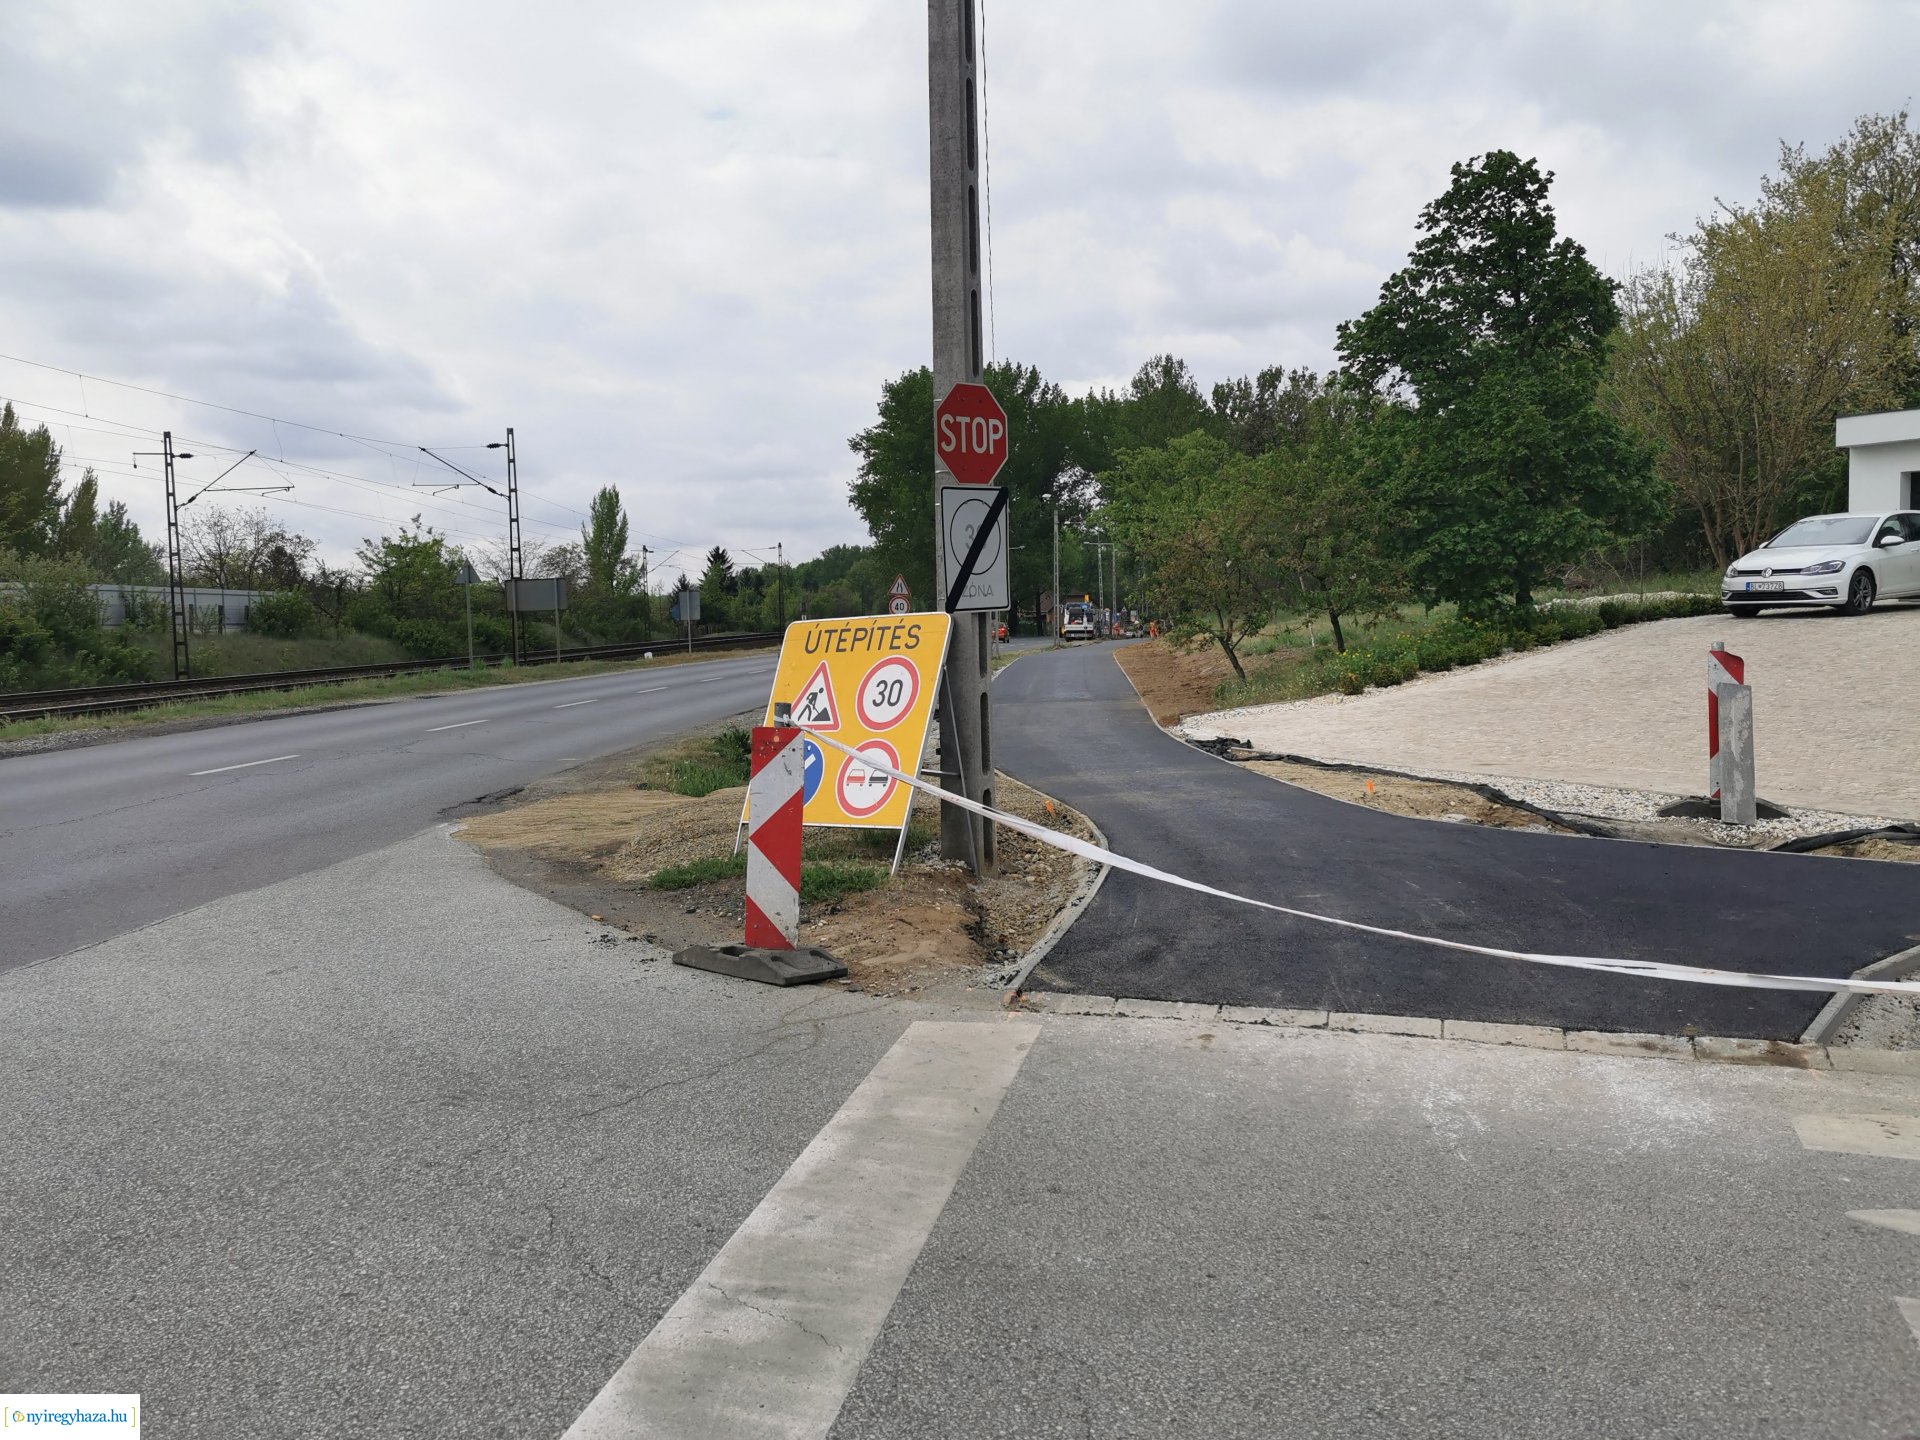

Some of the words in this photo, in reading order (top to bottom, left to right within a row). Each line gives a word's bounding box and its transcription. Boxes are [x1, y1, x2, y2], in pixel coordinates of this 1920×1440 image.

[940, 413, 1004, 455] STOP
[965, 524, 987, 550] 3
[895, 603, 905, 611] 40
[804, 618, 921, 654] ÚTÉPÍTÉS
[872, 679, 903, 707] 30
